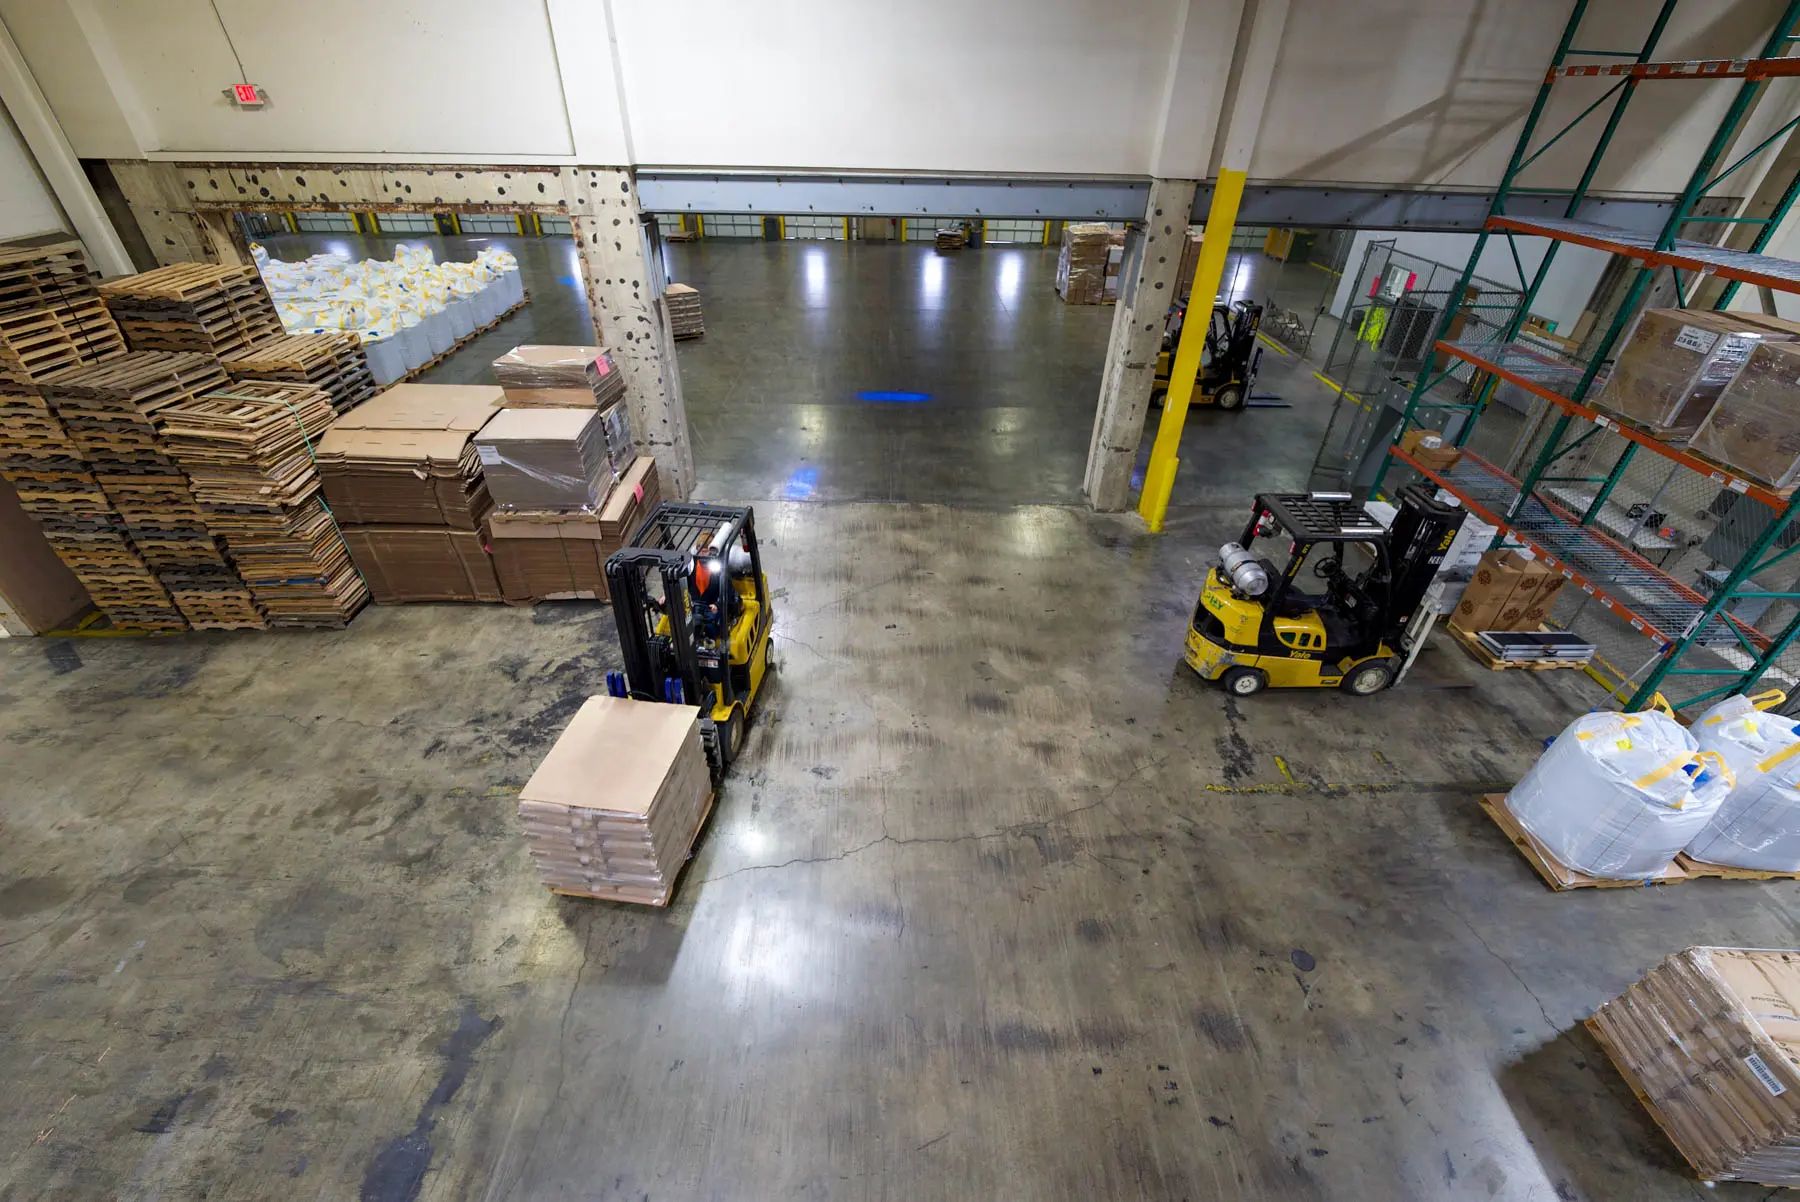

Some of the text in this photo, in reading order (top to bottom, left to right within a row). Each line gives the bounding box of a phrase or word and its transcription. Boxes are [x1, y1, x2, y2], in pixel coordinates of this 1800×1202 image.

[235, 85, 257, 102] EXIT
[1437, 529, 1456, 551] Yale
[1290, 650, 1311, 659] Yale
